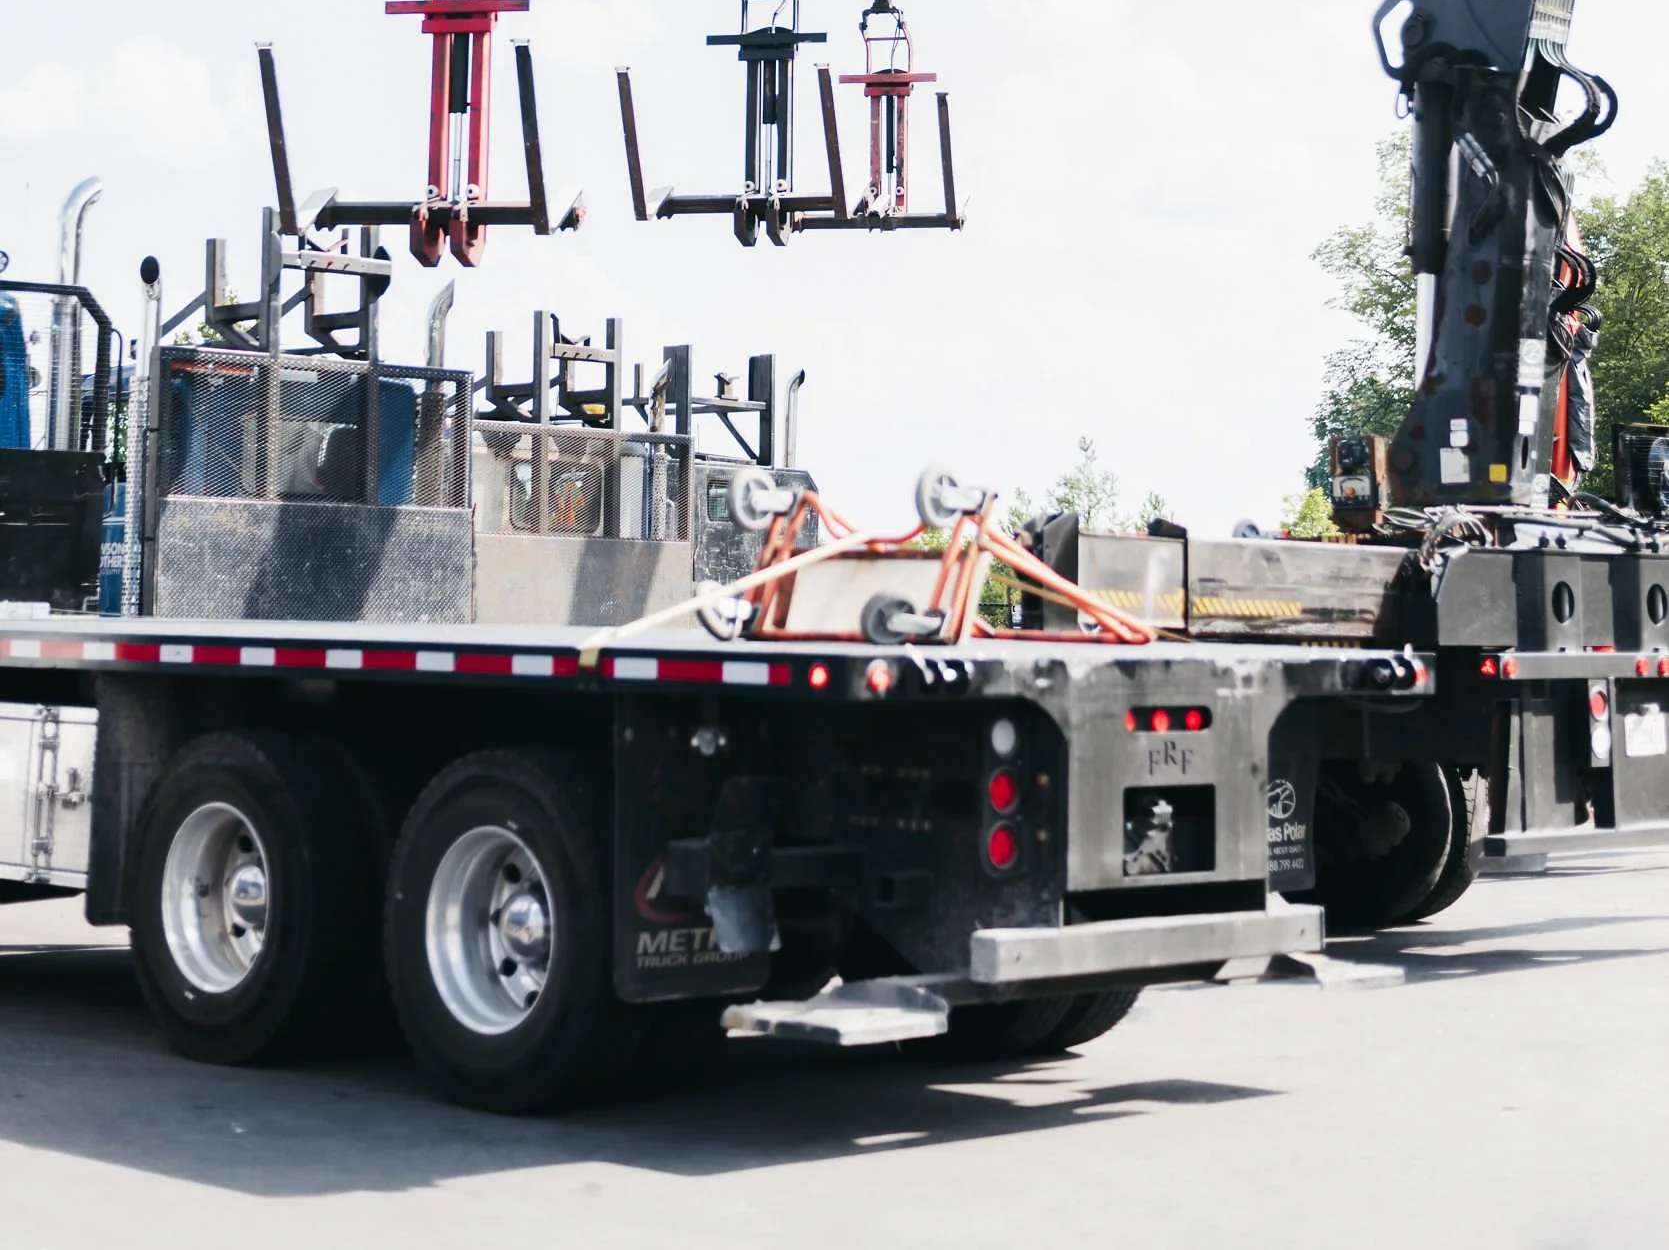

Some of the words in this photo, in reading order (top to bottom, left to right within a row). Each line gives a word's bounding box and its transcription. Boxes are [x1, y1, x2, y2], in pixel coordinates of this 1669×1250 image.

[1148, 740, 1194, 776] FRF
[1283, 822, 1306, 842] Polar
[637, 953, 688, 970] TRUCK
